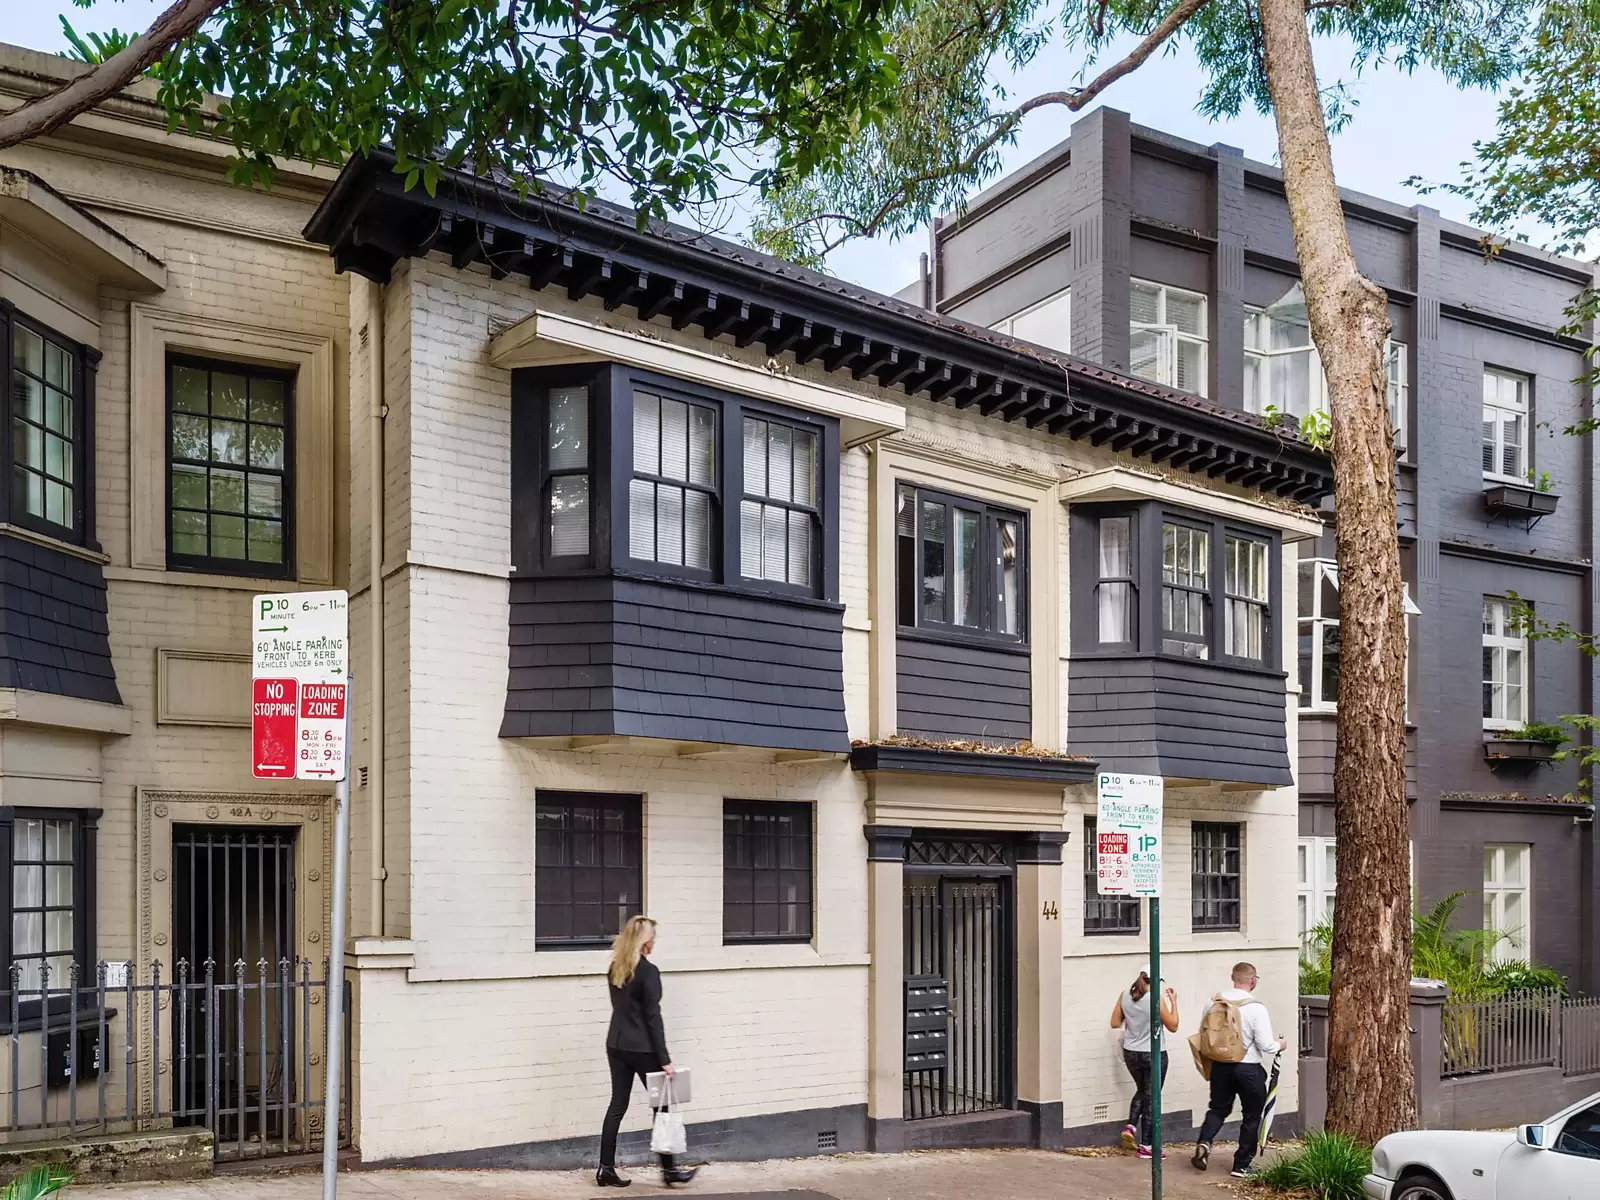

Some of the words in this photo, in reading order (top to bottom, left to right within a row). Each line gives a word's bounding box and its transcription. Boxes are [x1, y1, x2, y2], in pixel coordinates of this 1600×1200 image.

[261, 600, 274, 620] P
[276, 599, 288, 610] 10
[257, 642, 268, 652] 60
[273, 640, 302, 651] ANGLE
[306, 640, 342, 650] PARKING
[264, 652, 290, 660] FRONT
[298, 652, 307, 660] TO
[314, 650, 336, 659] KERB
[257, 660, 288, 668] VEHICLES
[266, 684, 284, 698] NO
[303, 686, 344, 700] LOADING
[254, 703, 296, 716] STOPPING
[308, 702, 338, 716] ZONE
[1100, 834, 1127, 844] LOADING
[1103, 844, 1124, 853] ZONE
[1042, 900, 1058, 920] 44
